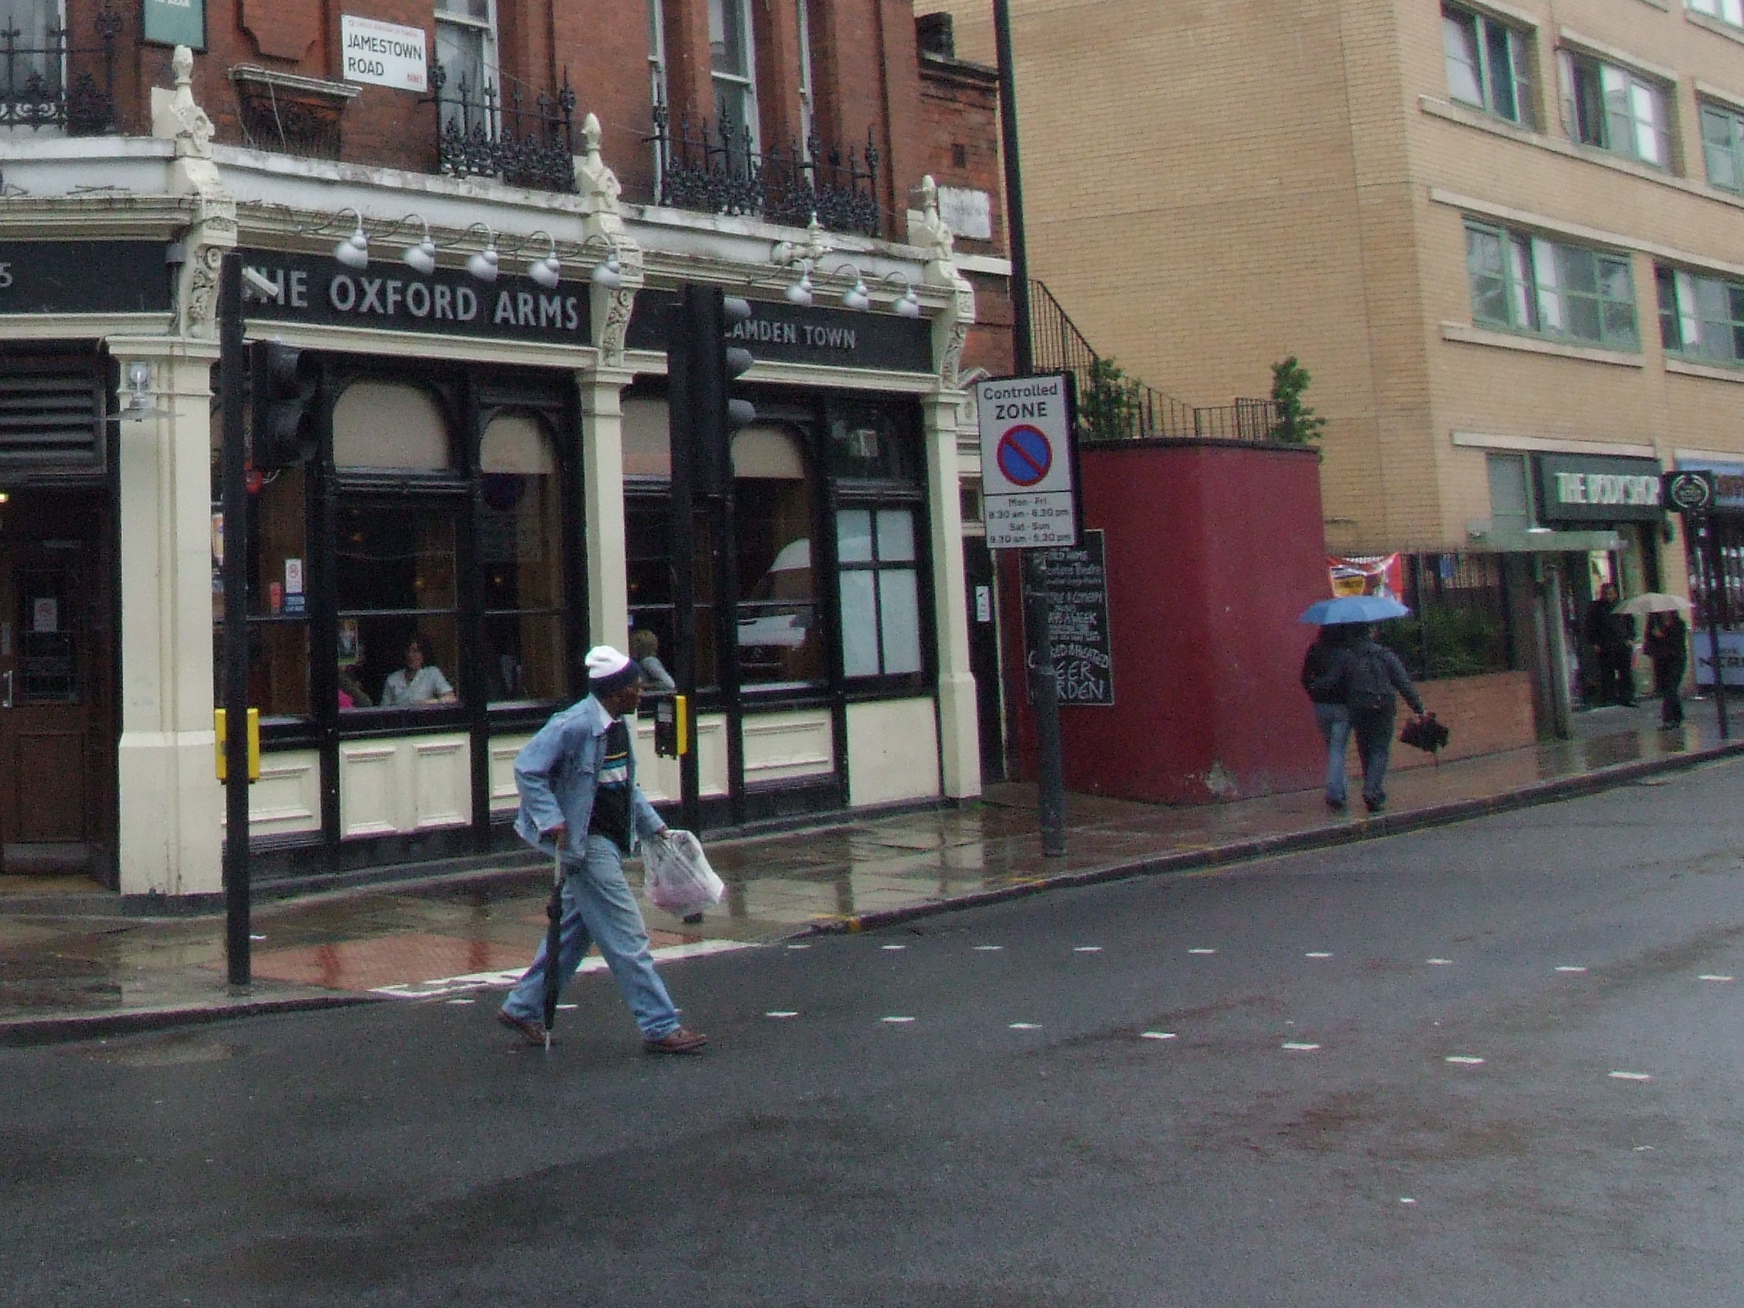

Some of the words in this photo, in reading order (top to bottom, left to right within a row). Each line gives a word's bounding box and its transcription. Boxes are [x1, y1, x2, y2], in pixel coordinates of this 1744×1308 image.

[348, 33, 422, 60] JAMESTOWN
[348, 57, 384, 76] ROAD
[259, 266, 308, 307] HE
[329, 274, 477, 322] OXFORD
[494, 292, 579, 330] ARMS
[724, 319, 797, 343] AMDEN
[803, 325, 856, 349] TOWN
[984, 383, 1058, 401] Controlled
[995, 402, 1048, 421] ZONE
[1008, 498, 1027, 507] Mon
[1010, 522, 1024, 532] Sat
[1031, 521, 1050, 530] Sun
[1056, 661, 1096, 682] EER
[1057, 679, 1105, 701] RDEN
